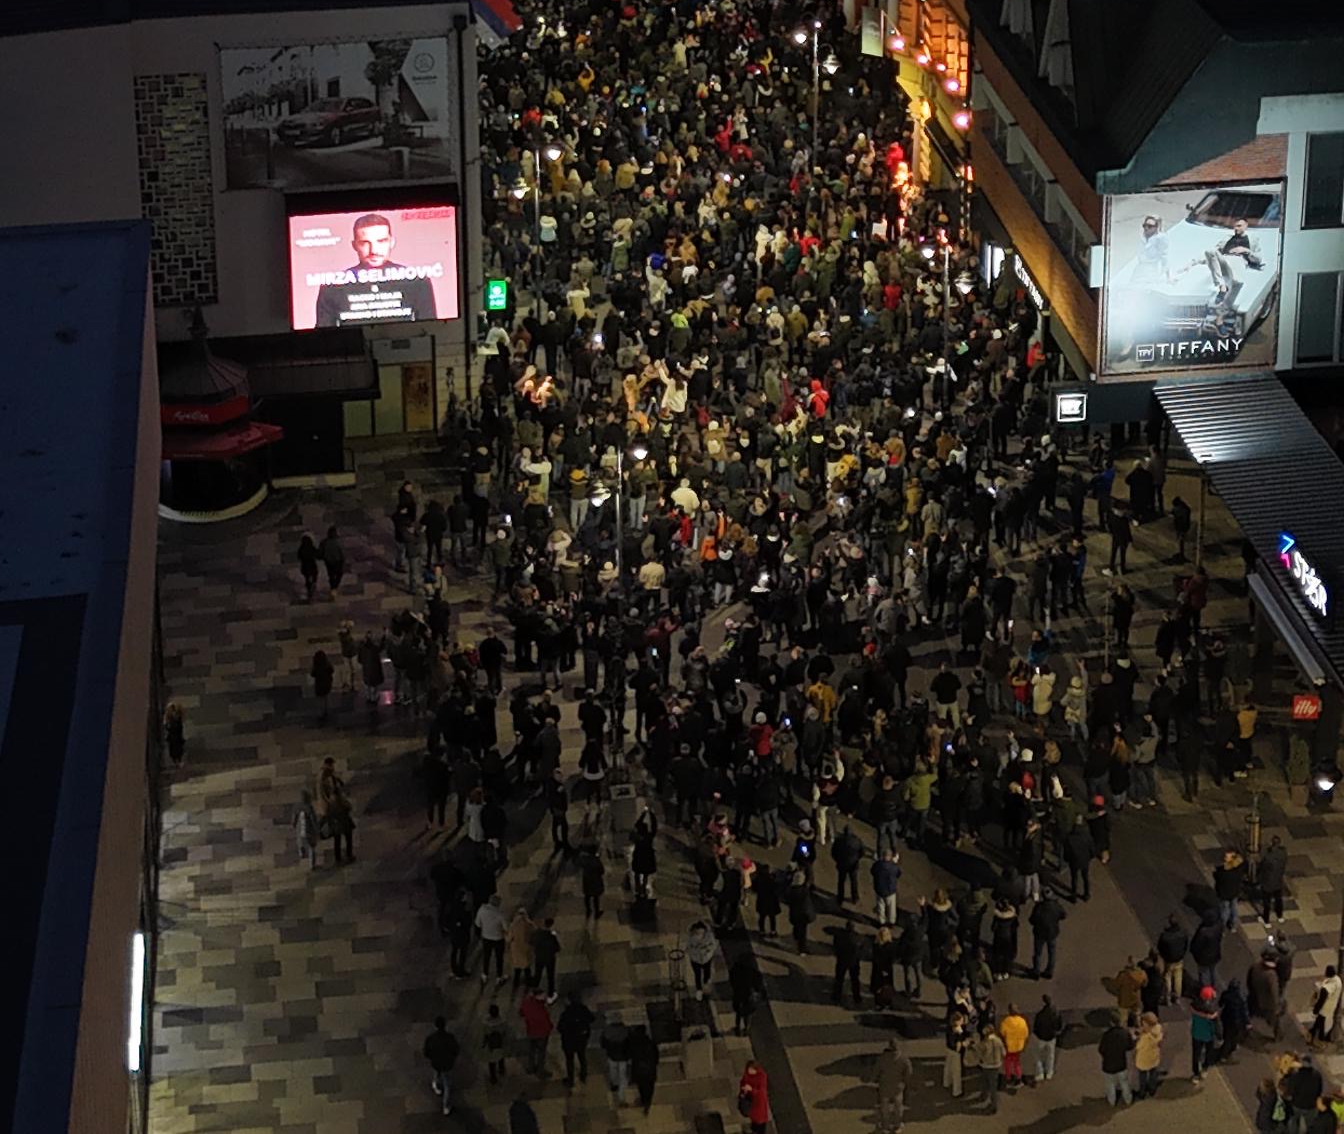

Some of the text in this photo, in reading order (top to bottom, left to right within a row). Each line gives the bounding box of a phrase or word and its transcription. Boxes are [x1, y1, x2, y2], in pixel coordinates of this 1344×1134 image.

[306, 262, 444, 286] MIRZA SELIMOVIĆ
[1156, 337, 1244, 356] TIFFANY
[1294, 699, 1317, 717] illy
